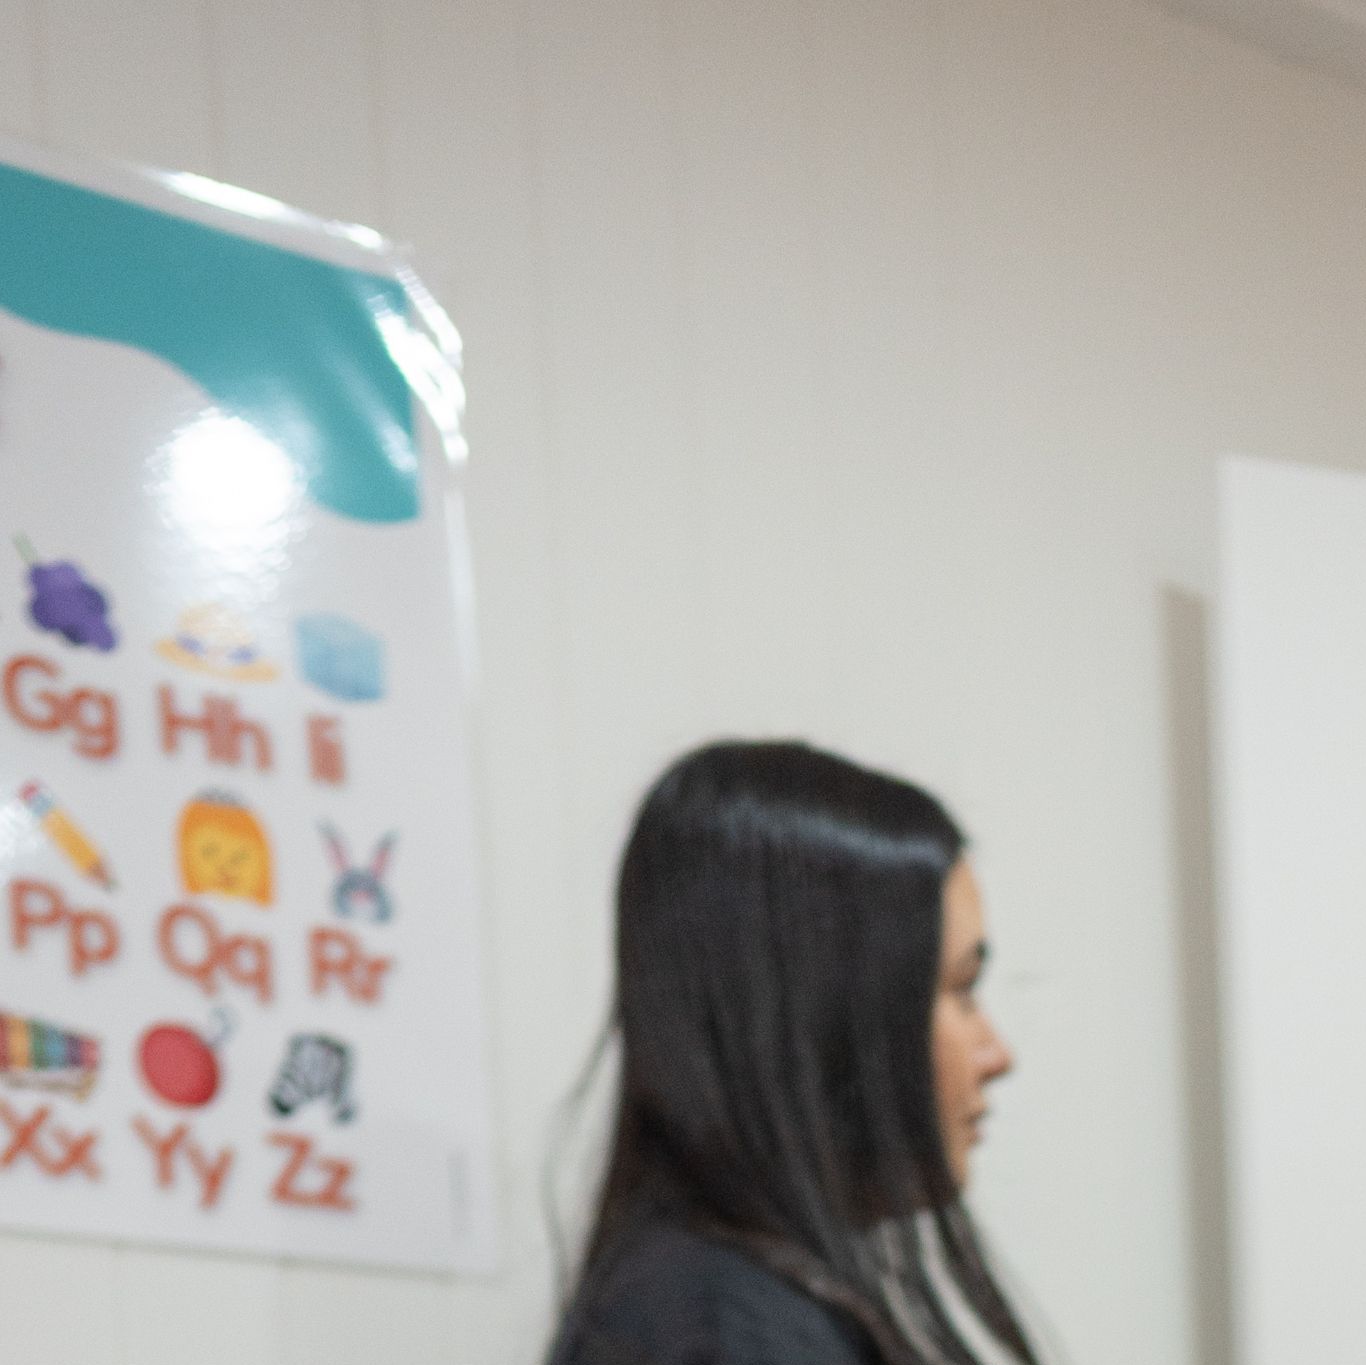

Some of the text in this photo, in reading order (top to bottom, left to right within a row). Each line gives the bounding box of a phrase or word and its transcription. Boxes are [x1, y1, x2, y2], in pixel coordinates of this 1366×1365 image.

[3, 654, 119, 761] Gg
[157, 682, 275, 773] Hh
[9, 880, 391, 1006] Pp Qq Rr
[0, 1103, 356, 1212] Xx Yy Zz
